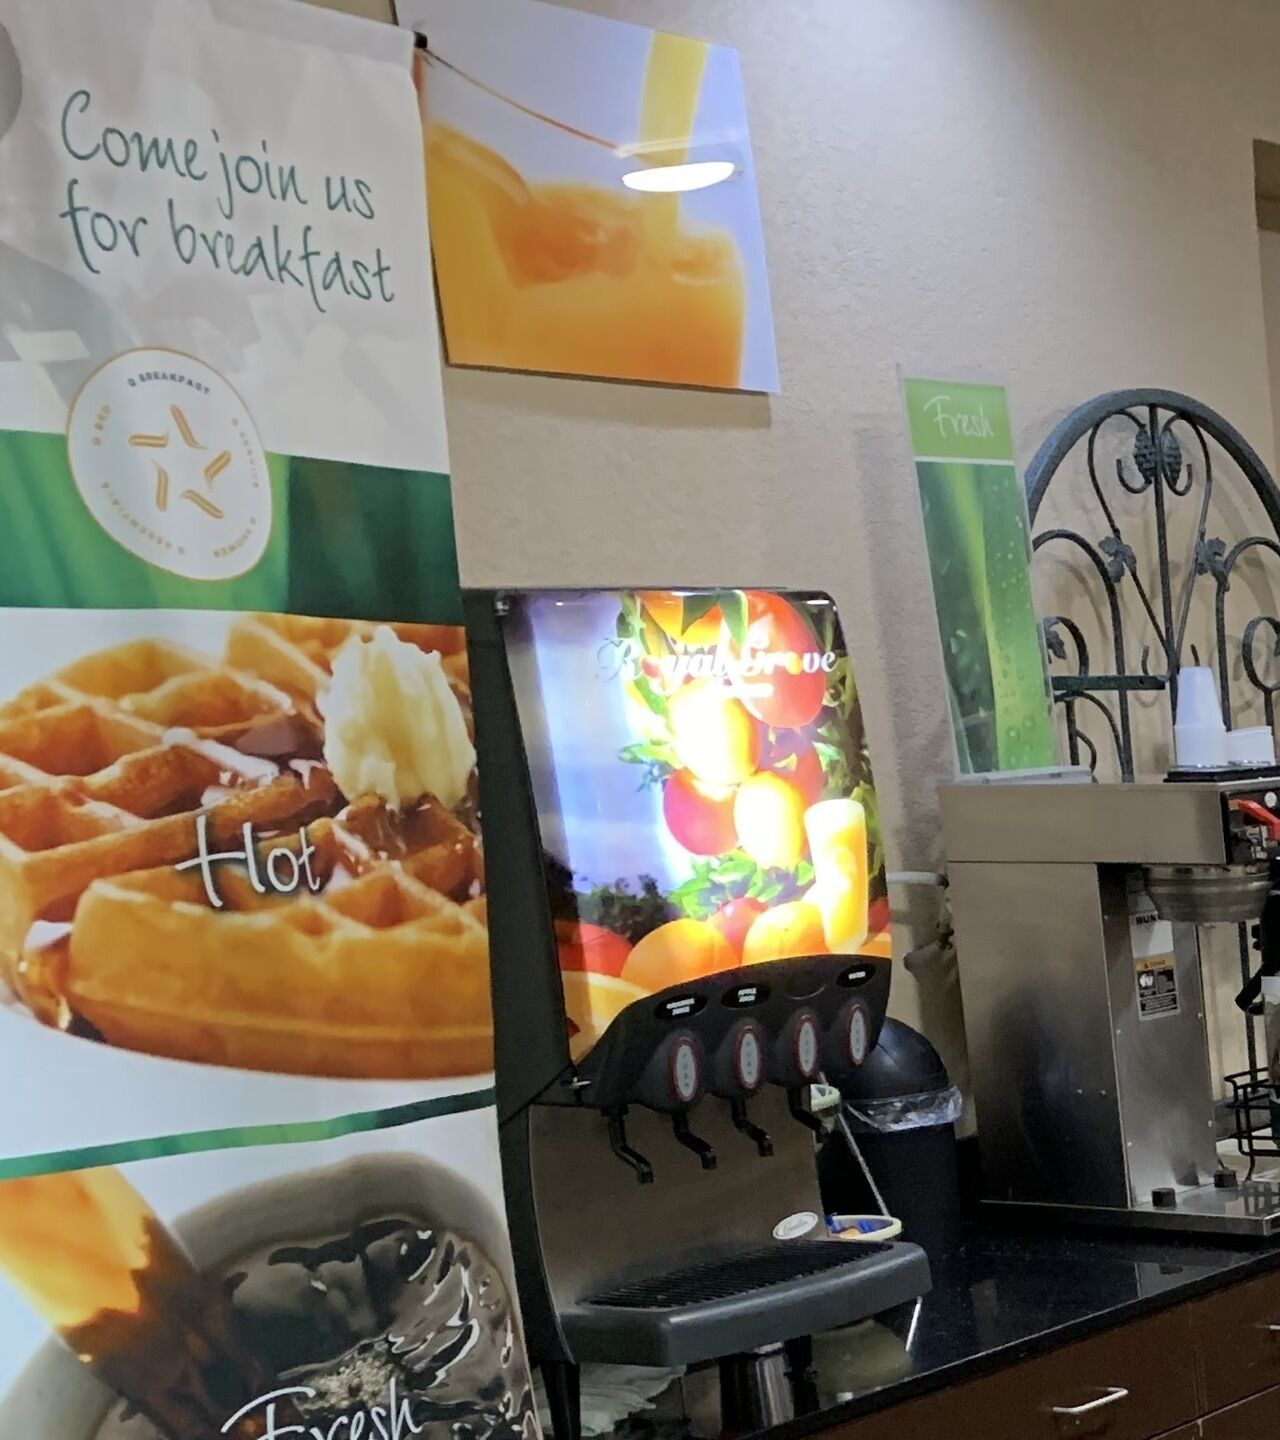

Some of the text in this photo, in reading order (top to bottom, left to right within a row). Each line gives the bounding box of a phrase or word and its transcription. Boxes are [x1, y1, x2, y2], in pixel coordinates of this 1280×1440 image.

[61, 89, 375, 220] Come join us
[59, 178, 395, 314] for breakfast
[138, 371, 210, 394] BREAKFAST
[922, 396, 994, 438] Fresh
[176, 815, 322, 909] Hot
[1136, 914, 1158, 926] BUN
